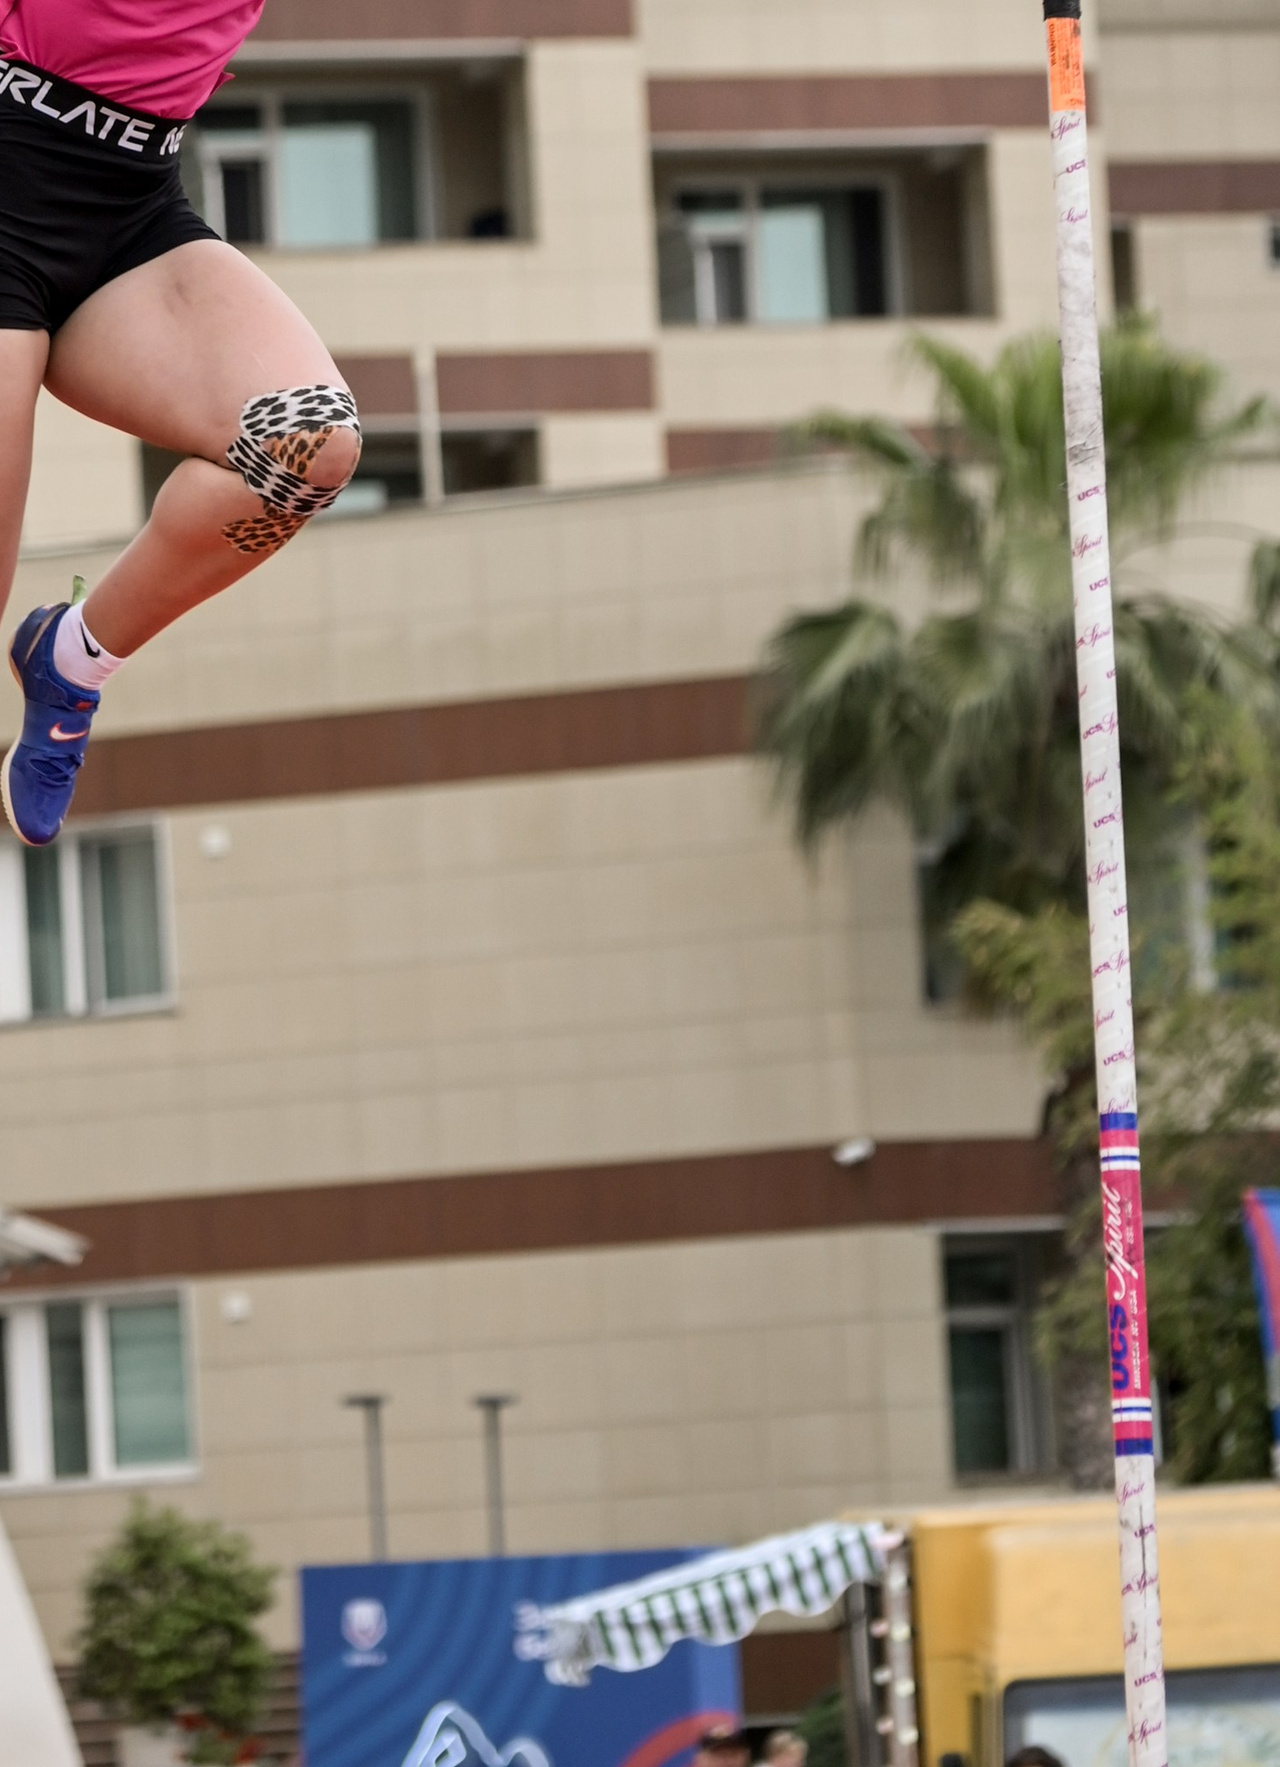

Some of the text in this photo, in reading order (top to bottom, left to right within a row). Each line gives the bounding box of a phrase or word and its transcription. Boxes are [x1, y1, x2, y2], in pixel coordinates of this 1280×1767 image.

[1077, 485, 1100, 501] UCS
[1093, 813, 1115, 828] UCS
[1113, 904, 1127, 916] UC
[1103, 1051, 1126, 1066] UCS
[1101, 1181, 1139, 1390] UCS Spirit
[1134, 1672, 1157, 1687] UCS
[1133, 1719, 1162, 1744] Spirit
